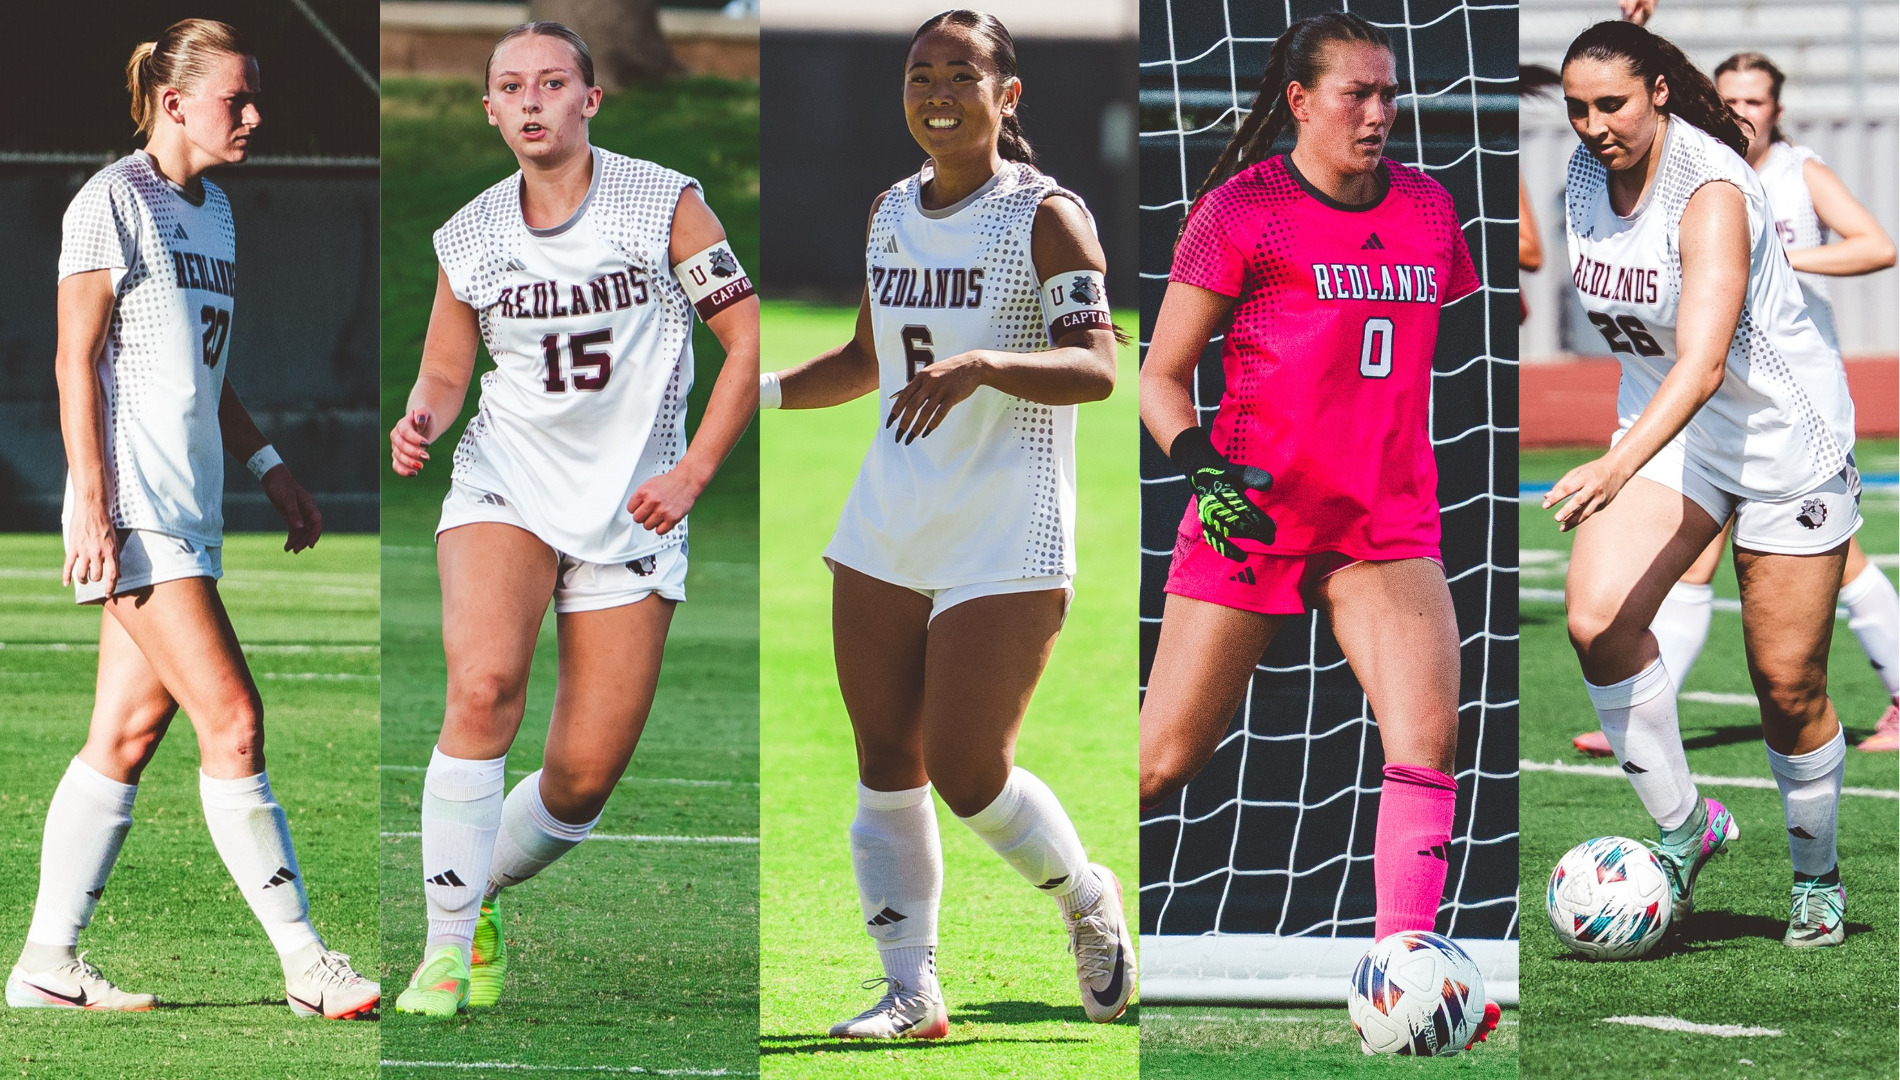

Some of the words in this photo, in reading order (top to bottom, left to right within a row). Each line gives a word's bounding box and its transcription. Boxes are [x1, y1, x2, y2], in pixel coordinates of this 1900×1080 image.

[500, 266, 649, 319] REDLANDS
[689, 264, 707, 286] U
[711, 277, 753, 306] CAPTAI
[1050, 285, 1064, 306] U
[1312, 263, 1438, 304] REDLANDS
[1573, 253, 1658, 305] REDLANDS
[201, 304, 230, 370] 20
[901, 324, 934, 384] 6
[1358, 317, 1396, 379] 0
[1587, 310, 1665, 357] 26
[540, 327, 613, 394] 15
